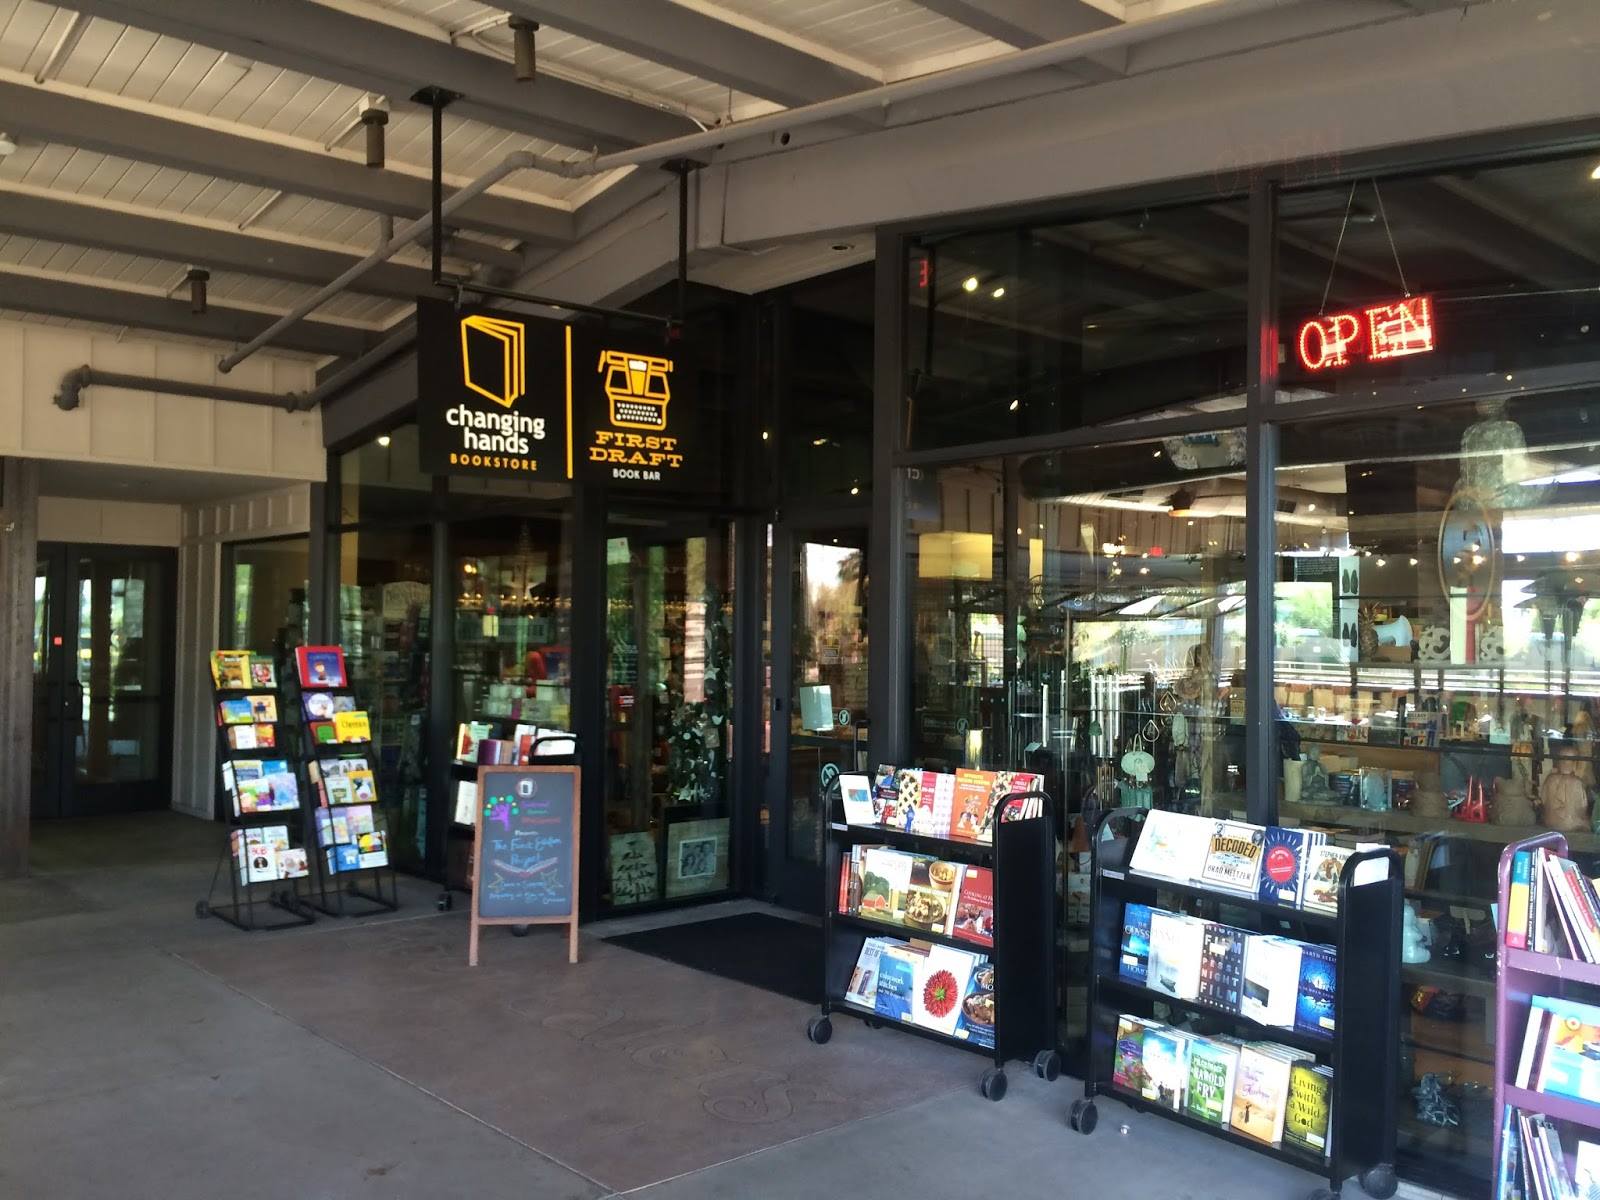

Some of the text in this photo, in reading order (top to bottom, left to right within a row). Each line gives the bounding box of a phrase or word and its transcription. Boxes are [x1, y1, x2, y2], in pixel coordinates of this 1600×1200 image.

[1299, 297, 1434, 369] OPEN
[446, 404, 546, 440] changing
[463, 427, 530, 455] hands
[595, 430, 678, 452] FIRST
[450, 453, 538, 471] BOOKSTORE
[589, 447, 684, 468] DRAFT
[612, 468, 661, 481] BOOK BAR
[1214, 837, 1258, 859] DECODED
[1124, 924, 1151, 939] ODYSS
[1196, 1080, 1216, 1099] FRY
[1293, 1074, 1322, 1097] Living
[1296, 1091, 1318, 1105] with
[1298, 1102, 1320, 1118] Wild
[1294, 1112, 1314, 1129] God
